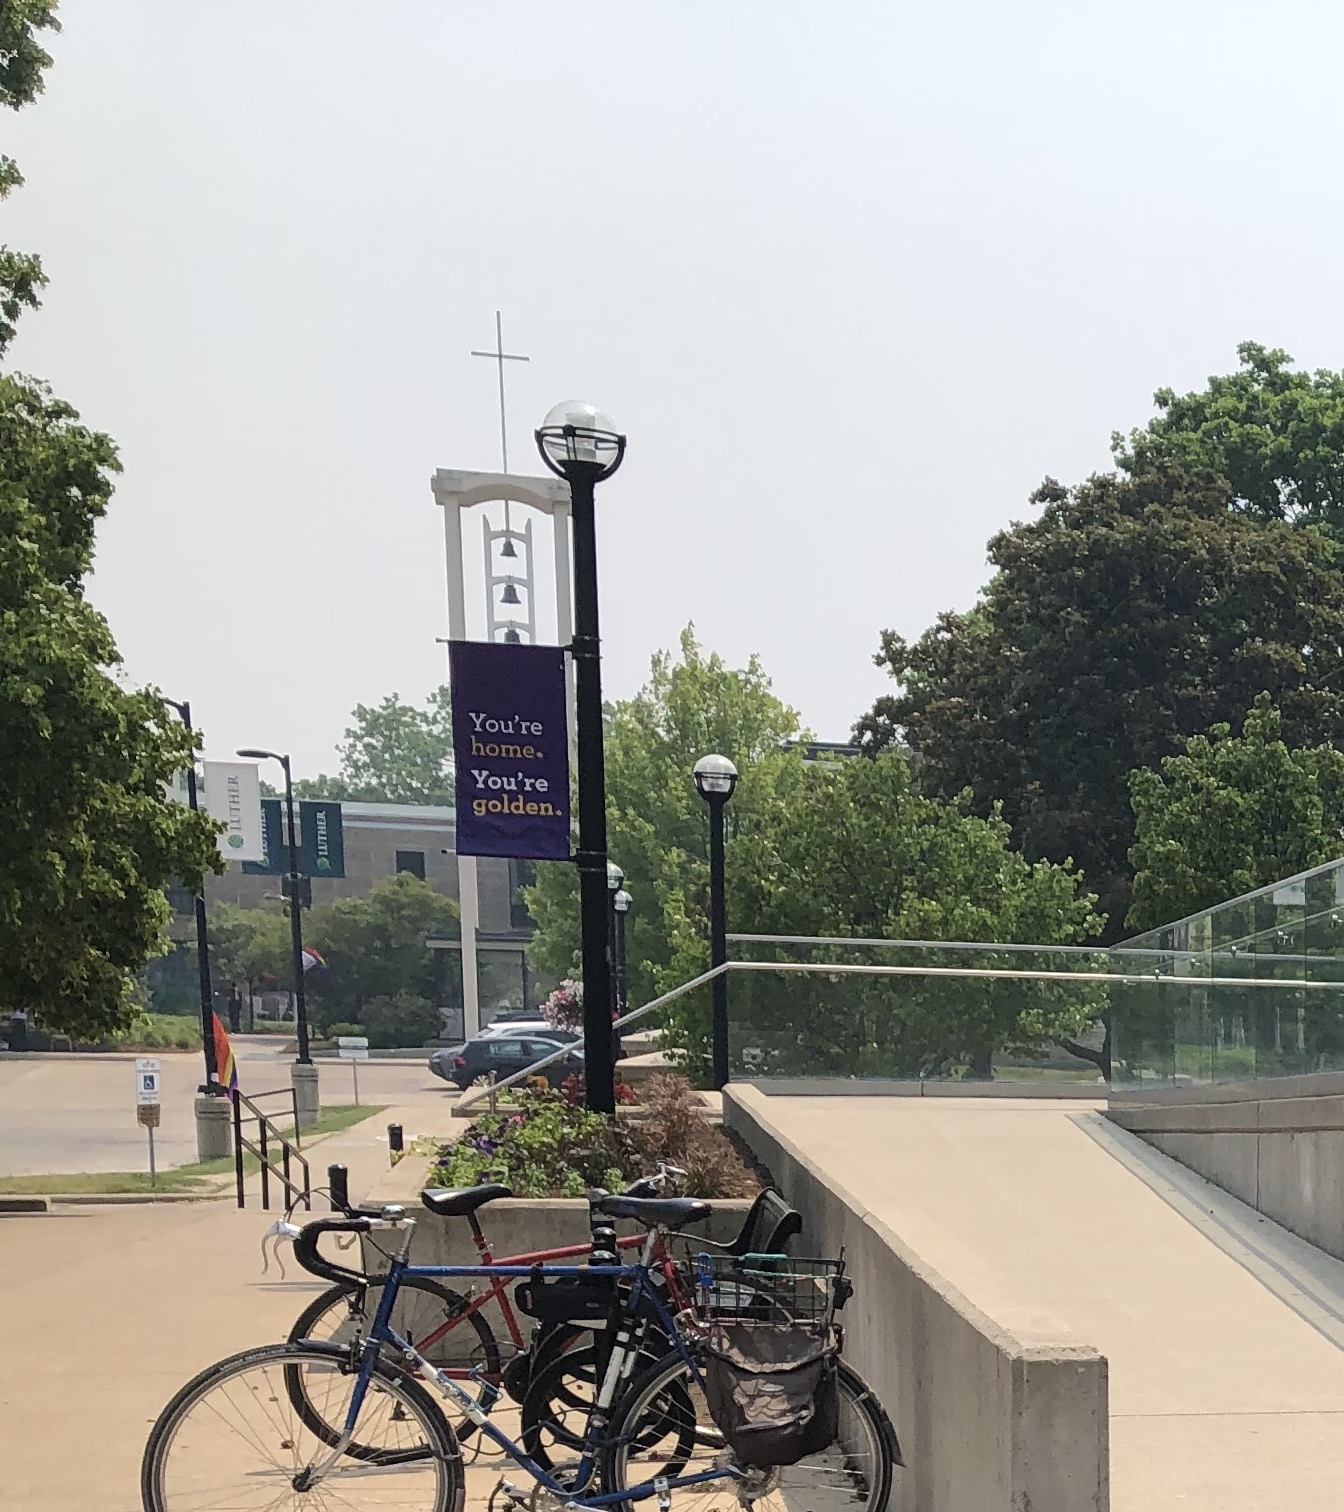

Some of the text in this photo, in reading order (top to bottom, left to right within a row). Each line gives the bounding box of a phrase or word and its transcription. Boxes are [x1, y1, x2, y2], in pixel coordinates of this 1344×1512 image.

[468, 712, 543, 735] You're
[470, 735, 544, 759] home.
[470, 769, 549, 792] You're
[228, 775, 241, 831] LUTHER
[472, 793, 562, 816] golden.
[317, 810, 328, 856] LUTHER
